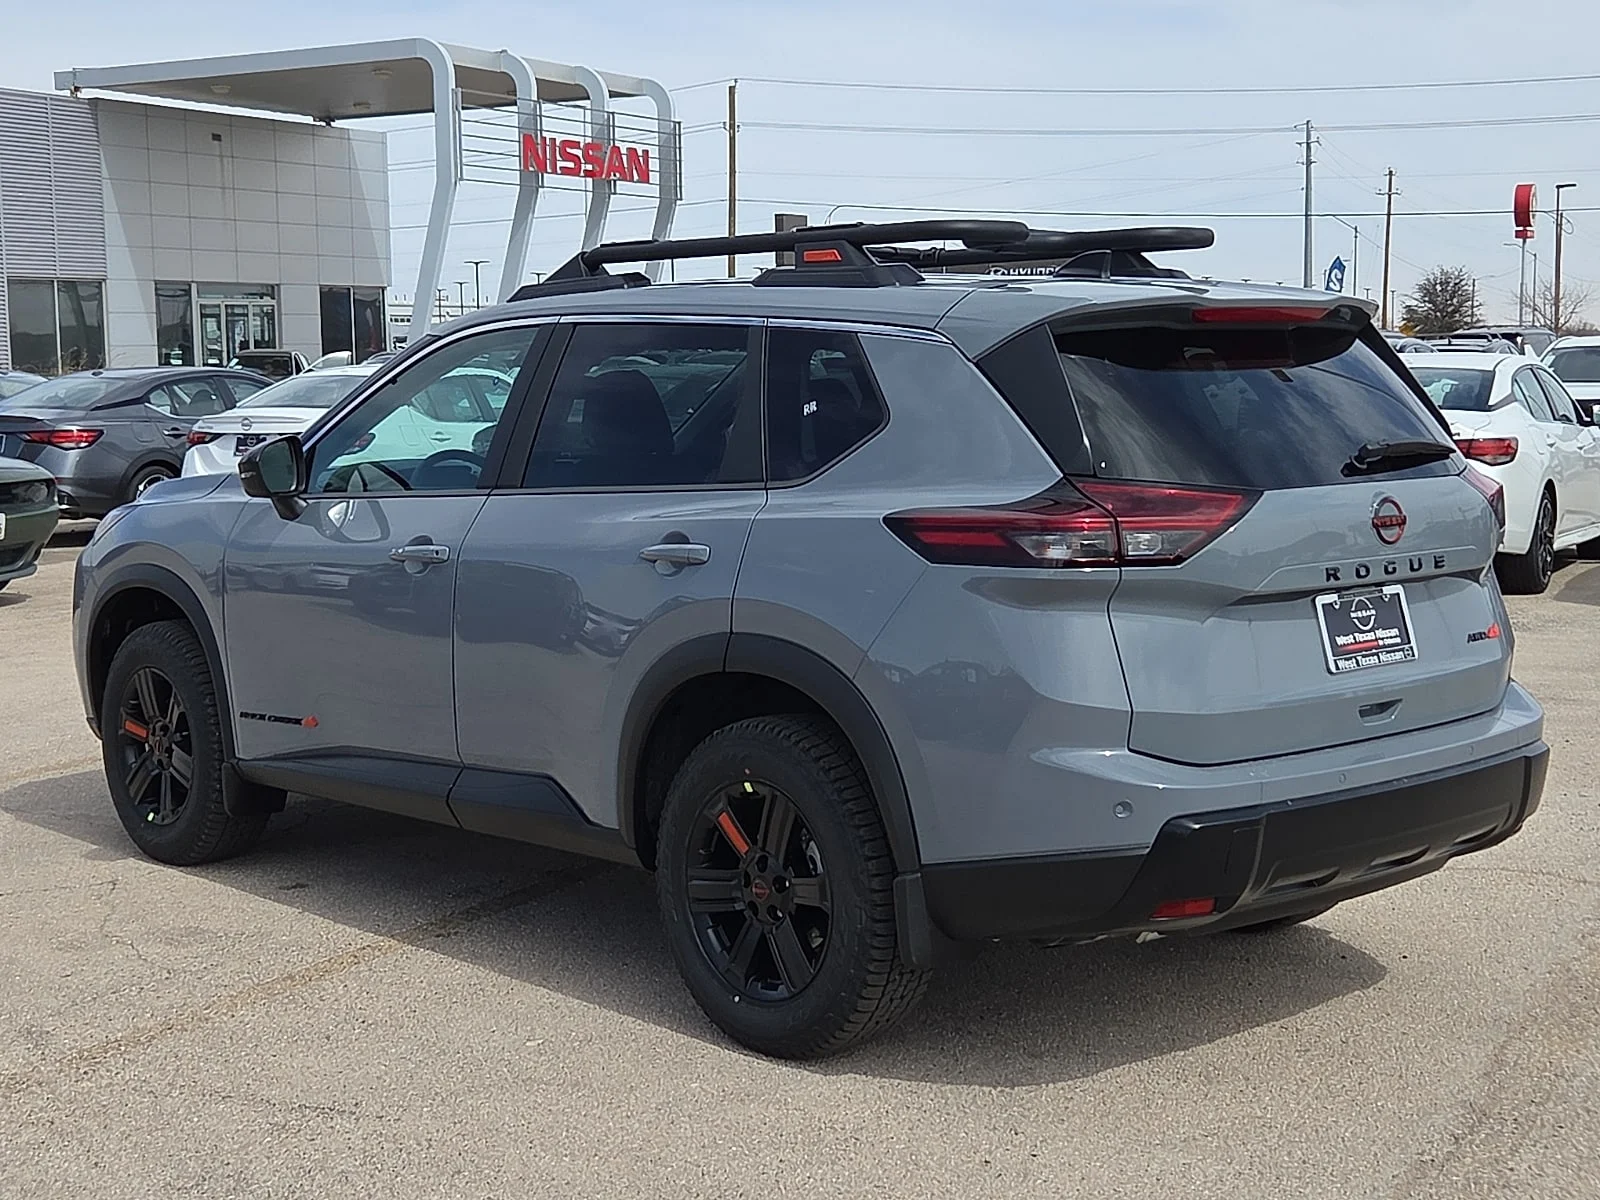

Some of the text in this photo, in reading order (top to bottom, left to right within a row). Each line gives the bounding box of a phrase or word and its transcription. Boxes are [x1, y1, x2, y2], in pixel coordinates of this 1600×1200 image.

[520, 133, 650, 184] NISSAN
[1009, 267, 1055, 276] HYUND
[1325, 555, 1446, 582] ROGUE
[1350, 609, 1376, 618] NISSAN
[1335, 634, 1355, 646] West
[1354, 632, 1376, 642] Texas
[1375, 628, 1399, 639] Nissan
[1336, 651, 1405, 670] West Texas Nissan
